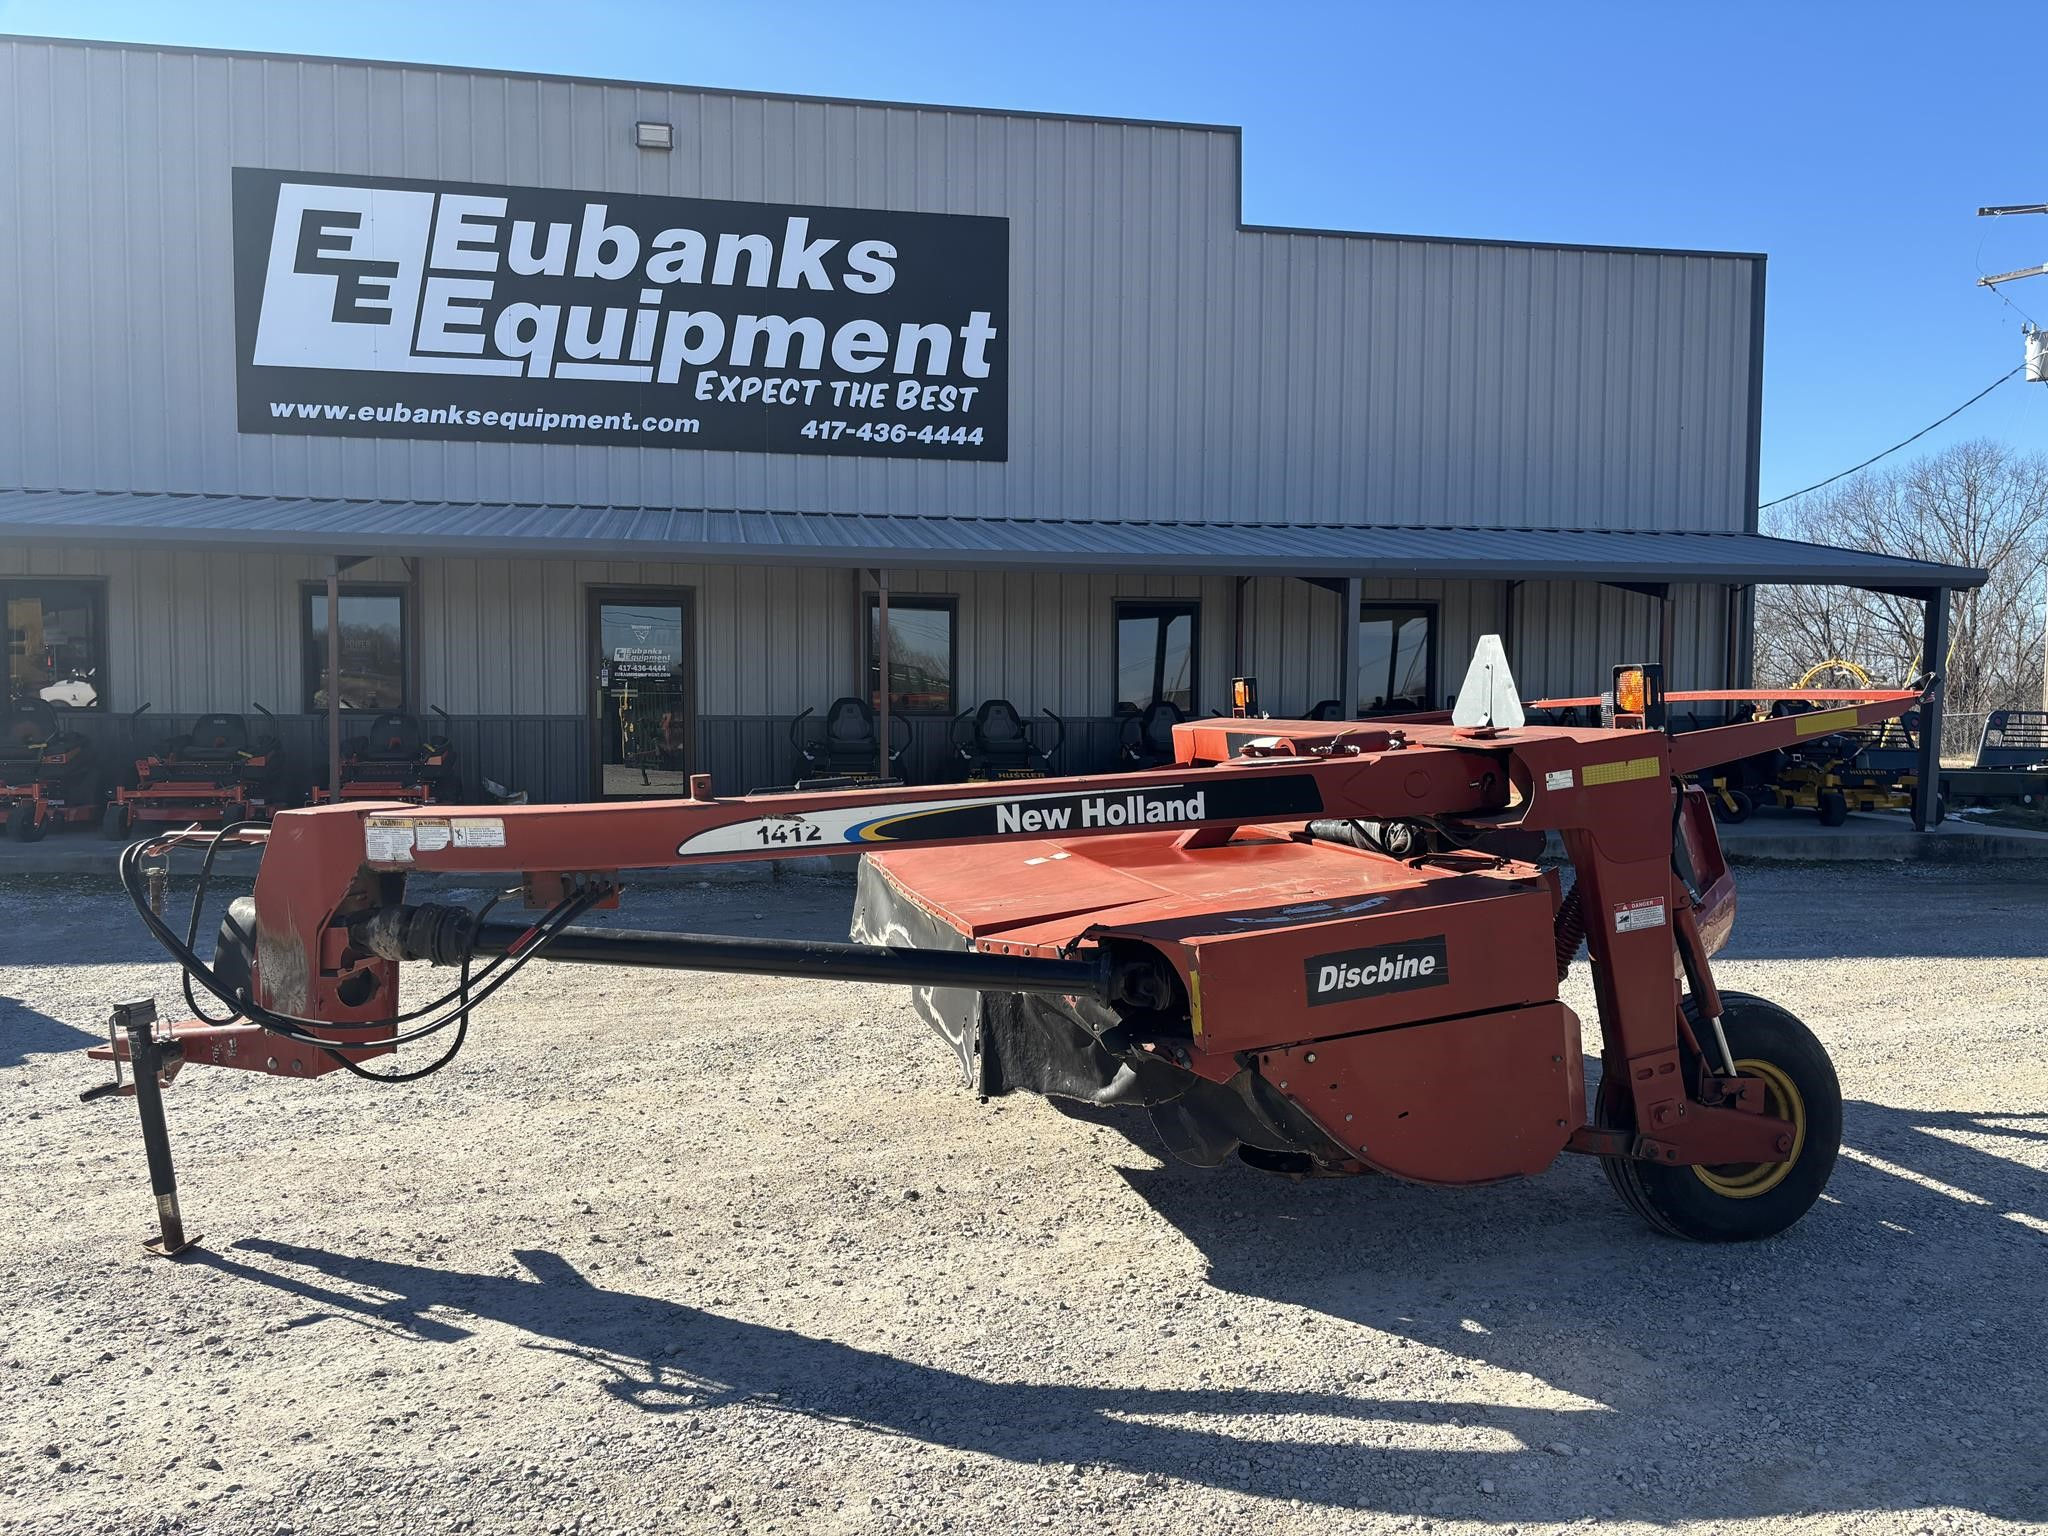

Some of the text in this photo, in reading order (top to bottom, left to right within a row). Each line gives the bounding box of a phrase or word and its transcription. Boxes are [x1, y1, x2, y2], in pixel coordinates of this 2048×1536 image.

[430, 194, 898, 294] Eubanks
[416, 277, 997, 384] Equipment
[694, 370, 979, 414] EXPECT THE BEST
[269, 401, 701, 435] www.eubanksequipment.com
[800, 420, 985, 447] 417-436-4444
[996, 791, 1206, 834] New Holland
[756, 823, 822, 845] 1412
[1631, 900, 1655, 909] DANGER
[1317, 953, 1436, 993] Discbine
